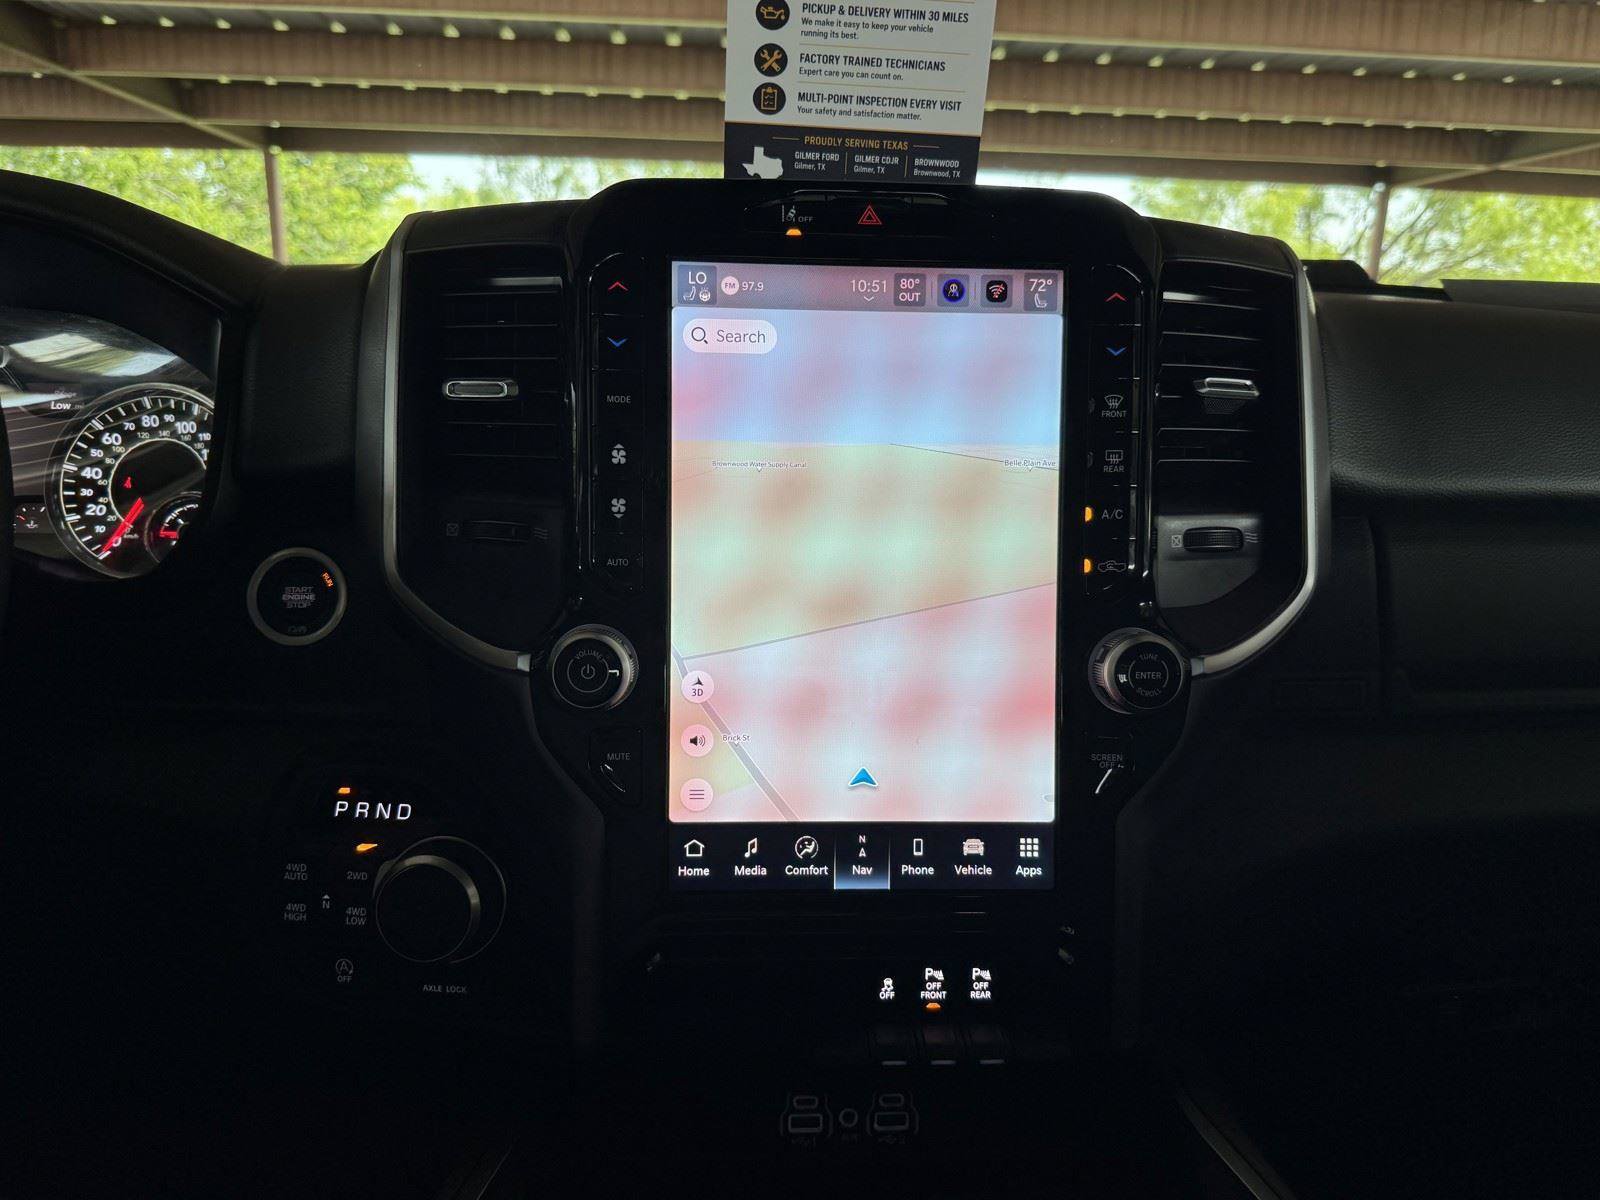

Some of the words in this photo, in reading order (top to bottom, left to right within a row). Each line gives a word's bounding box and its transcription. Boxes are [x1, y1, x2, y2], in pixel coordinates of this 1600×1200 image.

[802, 3, 836, 16] PICKUP
[838, 6, 845, 16] &
[848, 5, 891, 19] DELIVERY
[893, 9, 926, 21] WITHIN
[928, 11, 940, 22] 30
[942, 12, 969, 23] MILES
[801, 17, 813, 26] We
[814, 18, 834, 27] make
[836, 19, 842, 27] it
[843, 21, 860, 31] easy
[862, 21, 869, 29] to
[872, 21, 888, 32] keep
[890, 24, 906, 33] your
[908, 24, 934, 33] vehicle
[801, 29, 828, 40] running
[830, 30, 839, 39] its
[841, 31, 859, 40] best.
[800, 53, 840, 66] FACTORY
[843, 56, 883, 68] TRAINED
[885, 58, 946, 72] TECHNICIANS
[799, 67, 822, 78] Expert
[824, 70, 840, 78] care
[841, 71, 854, 80] you
[856, 71, 869, 79] can
[871, 71, 891, 80] count
[893, 73, 903, 81] on.
[798, 92, 853, 105] MULTI-POINT
[856, 95, 908, 108] INSPECTION
[910, 98, 938, 110] EVERY
[940, 100, 962, 111] VISIT
[797, 106, 813, 115] Your
[814, 107, 836, 117] safety
[838, 109, 851, 117] and
[853, 109, 895, 119] satisfaction
[896, 112, 922, 121] matter.
[804, 135, 842, 147] PROUDLY
[844, 137, 880, 149] SERVING
[882, 140, 909, 151] TEXAS
[795, 151, 820, 161] GILMER
[822, 153, 840, 162] FORD
[854, 155, 880, 164] GILMER
[794, 161, 816, 171] Gilmer,
[817, 163, 826, 171] TX
[914, 158, 959, 168] BROWNWOOD
[854, 165, 875, 174] Gilmer,
[877, 166, 885, 174] TX
[914, 168, 951, 179] Brownwood,
[952, 170, 961, 178] TX
[688, 272, 707, 285] LO
[724, 282, 736, 290] FM
[742, 281, 764, 292] 97.9
[850, 280, 887, 293] 10:51
[900, 278, 920, 290] 80°
[1029, 279, 1053, 292] 72°
[899, 292, 921, 302] OUT
[716, 329, 766, 344] Search
[607, 395, 631, 404] MODE
[50, 401, 71, 410] Low
[164, 414, 175, 423] 90
[1101, 410, 1127, 418] FRONT
[123, 422, 136, 431] 70
[141, 415, 160, 428] 80
[175, 421, 197, 434] 100
[102, 433, 122, 445] 60
[199, 433, 211, 441] 110
[90, 449, 104, 457] 50
[1005, 459, 1022, 467] Belle
[1042, 459, 1056, 467] Ave
[81, 467, 102, 480] 40
[80, 488, 94, 496] 30
[85, 504, 107, 516] 20
[1101, 509, 1124, 520] A/C
[95, 525, 106, 533] 10
[112, 536, 122, 547] 0
[607, 558, 629, 566] AUTO
[575, 650, 602, 660] VOLUME
[1135, 672, 1162, 680] ENTER
[692, 688, 703, 697] 3D
[607, 753, 630, 761] MUTE
[1091, 754, 1123, 762] SCREEN
[858, 835, 866, 843] N
[286, 864, 307, 872] 4WD
[678, 865, 710, 877] Home
[734, 864, 767, 876] Media
[785, 864, 828, 876] Comfort
[852, 864, 873, 875] Nav
[901, 864, 935, 876] Phone
[954, 864, 993, 876] Vehicle
[1015, 865, 1042, 879] Apps
[284, 872, 308, 881] AUTO
[346, 872, 368, 880] 2WD
[286, 904, 306, 912] 4WD
[322, 900, 330, 909] N
[284, 912, 307, 921] HIGH
[346, 907, 367, 916] 4WD
[346, 917, 366, 925] LOW
[423, 985, 442, 993] AXLE
[446, 986, 466, 994] LOCK
[926, 982, 942, 990] OFF
[973, 982, 989, 990] OFF
[879, 991, 895, 1000] OFF
[920, 991, 947, 1000] FRONT
[970, 991, 992, 999] REAR
